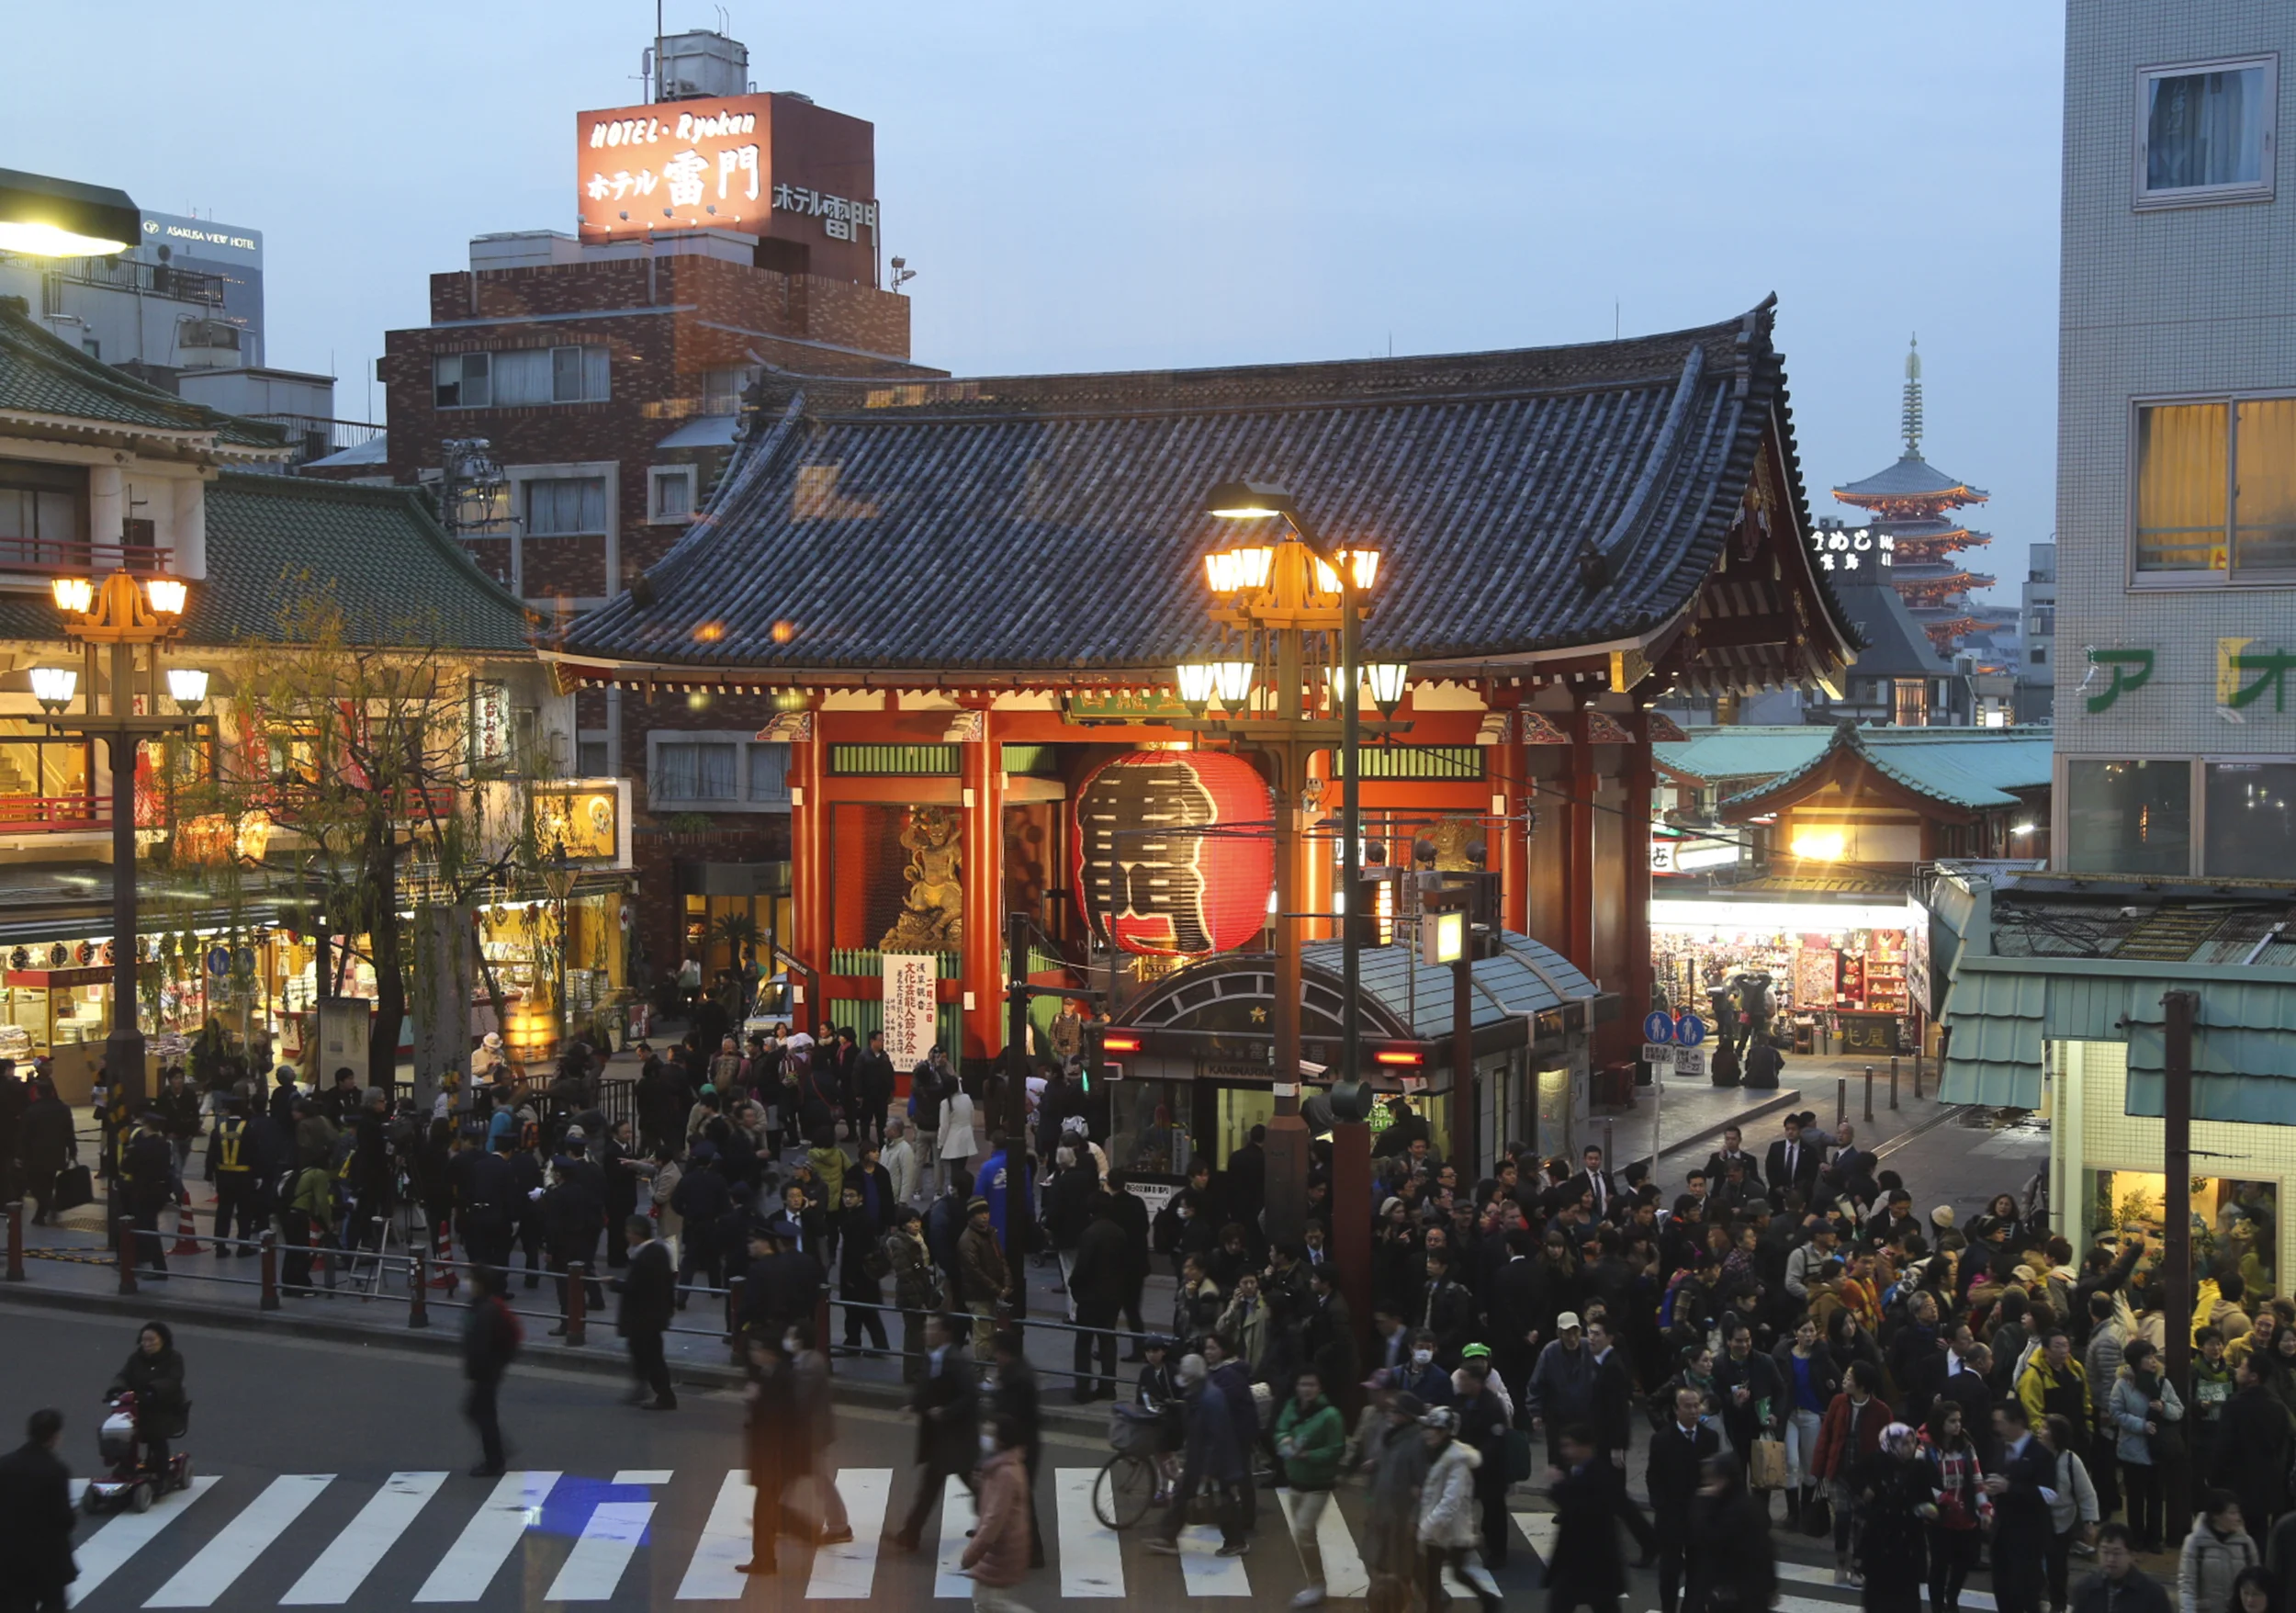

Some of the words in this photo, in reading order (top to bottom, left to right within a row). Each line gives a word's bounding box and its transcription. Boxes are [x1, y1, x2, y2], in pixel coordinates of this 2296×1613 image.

[587, 143, 760, 207] ホテル雷門
[166, 226, 205, 241] ASAKUSA
[206, 232, 229, 244] VIEW
[231, 237, 255, 250] HOTEL
[773, 184, 878, 247] ホテル雷門
[905, 962, 917, 1055] 文化芸能人節分会
[926, 978, 934, 1023] 二月三日
